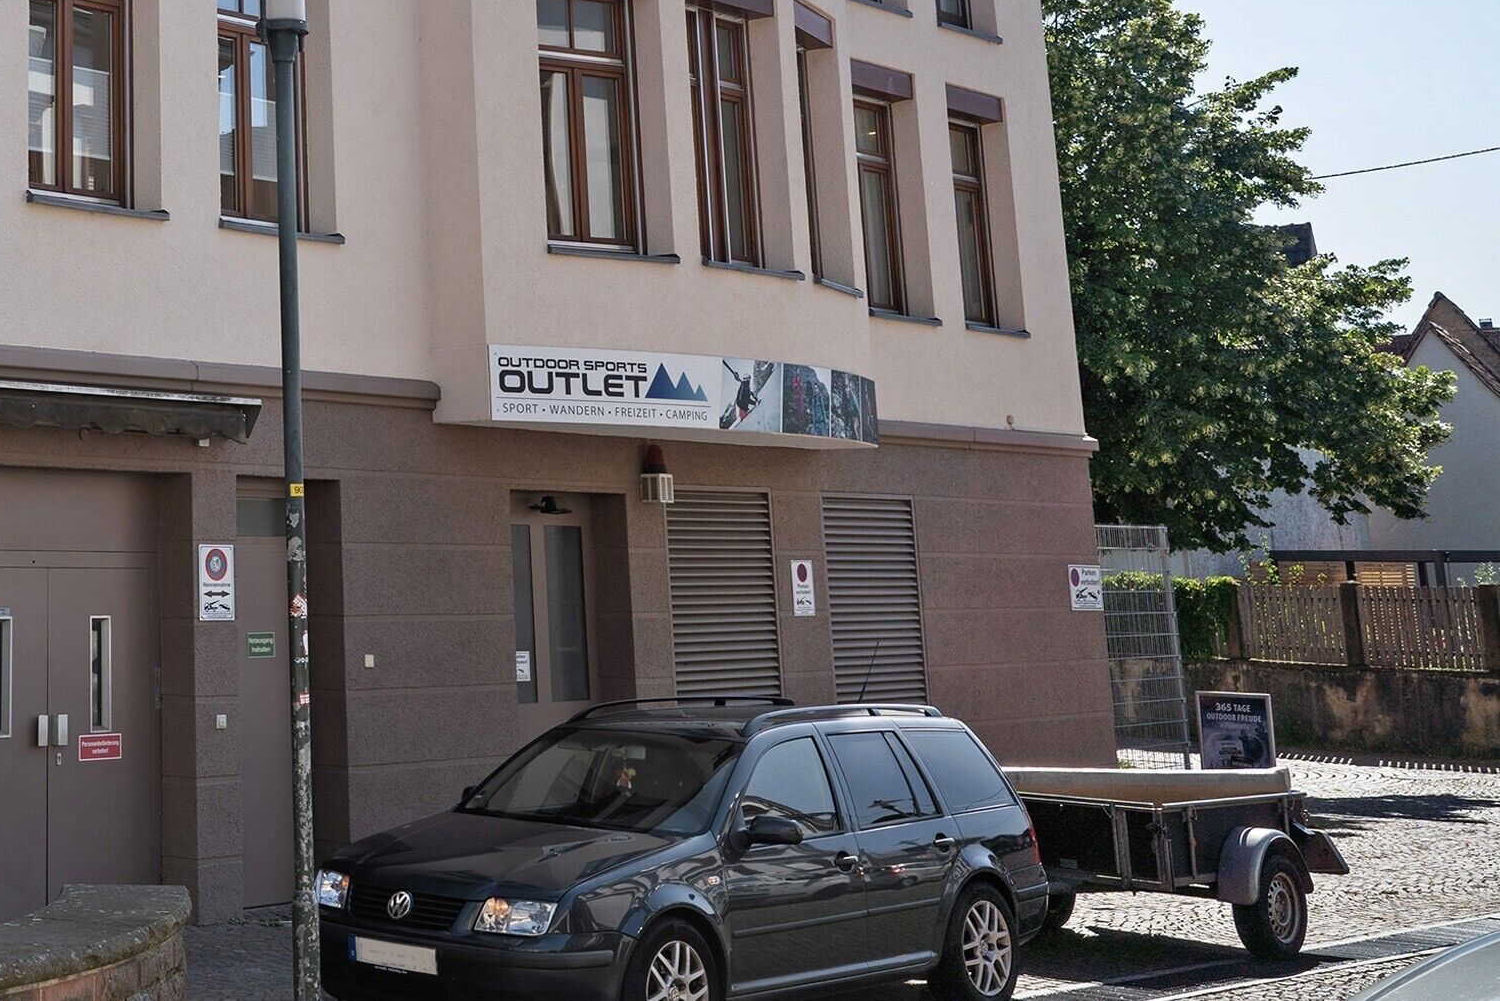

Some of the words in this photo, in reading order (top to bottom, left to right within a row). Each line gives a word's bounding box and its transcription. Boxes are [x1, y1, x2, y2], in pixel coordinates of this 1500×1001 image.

[498, 356, 580, 370] OUTDOOR
[584, 359, 647, 374] SPORTS
[499, 369, 648, 398] OUTLET
[502, 402, 538, 414] SPORT
[549, 404, 605, 416] WANDERN
[615, 406, 656, 418] FREIZEIT
[665, 409, 708, 421] CAMPING
[1215, 702, 1232, 712] 365
[1233, 703, 1251, 713] TAGE
[1206, 712, 1236, 721] OUTDOOR
[1237, 714, 1262, 723] FREUDE
